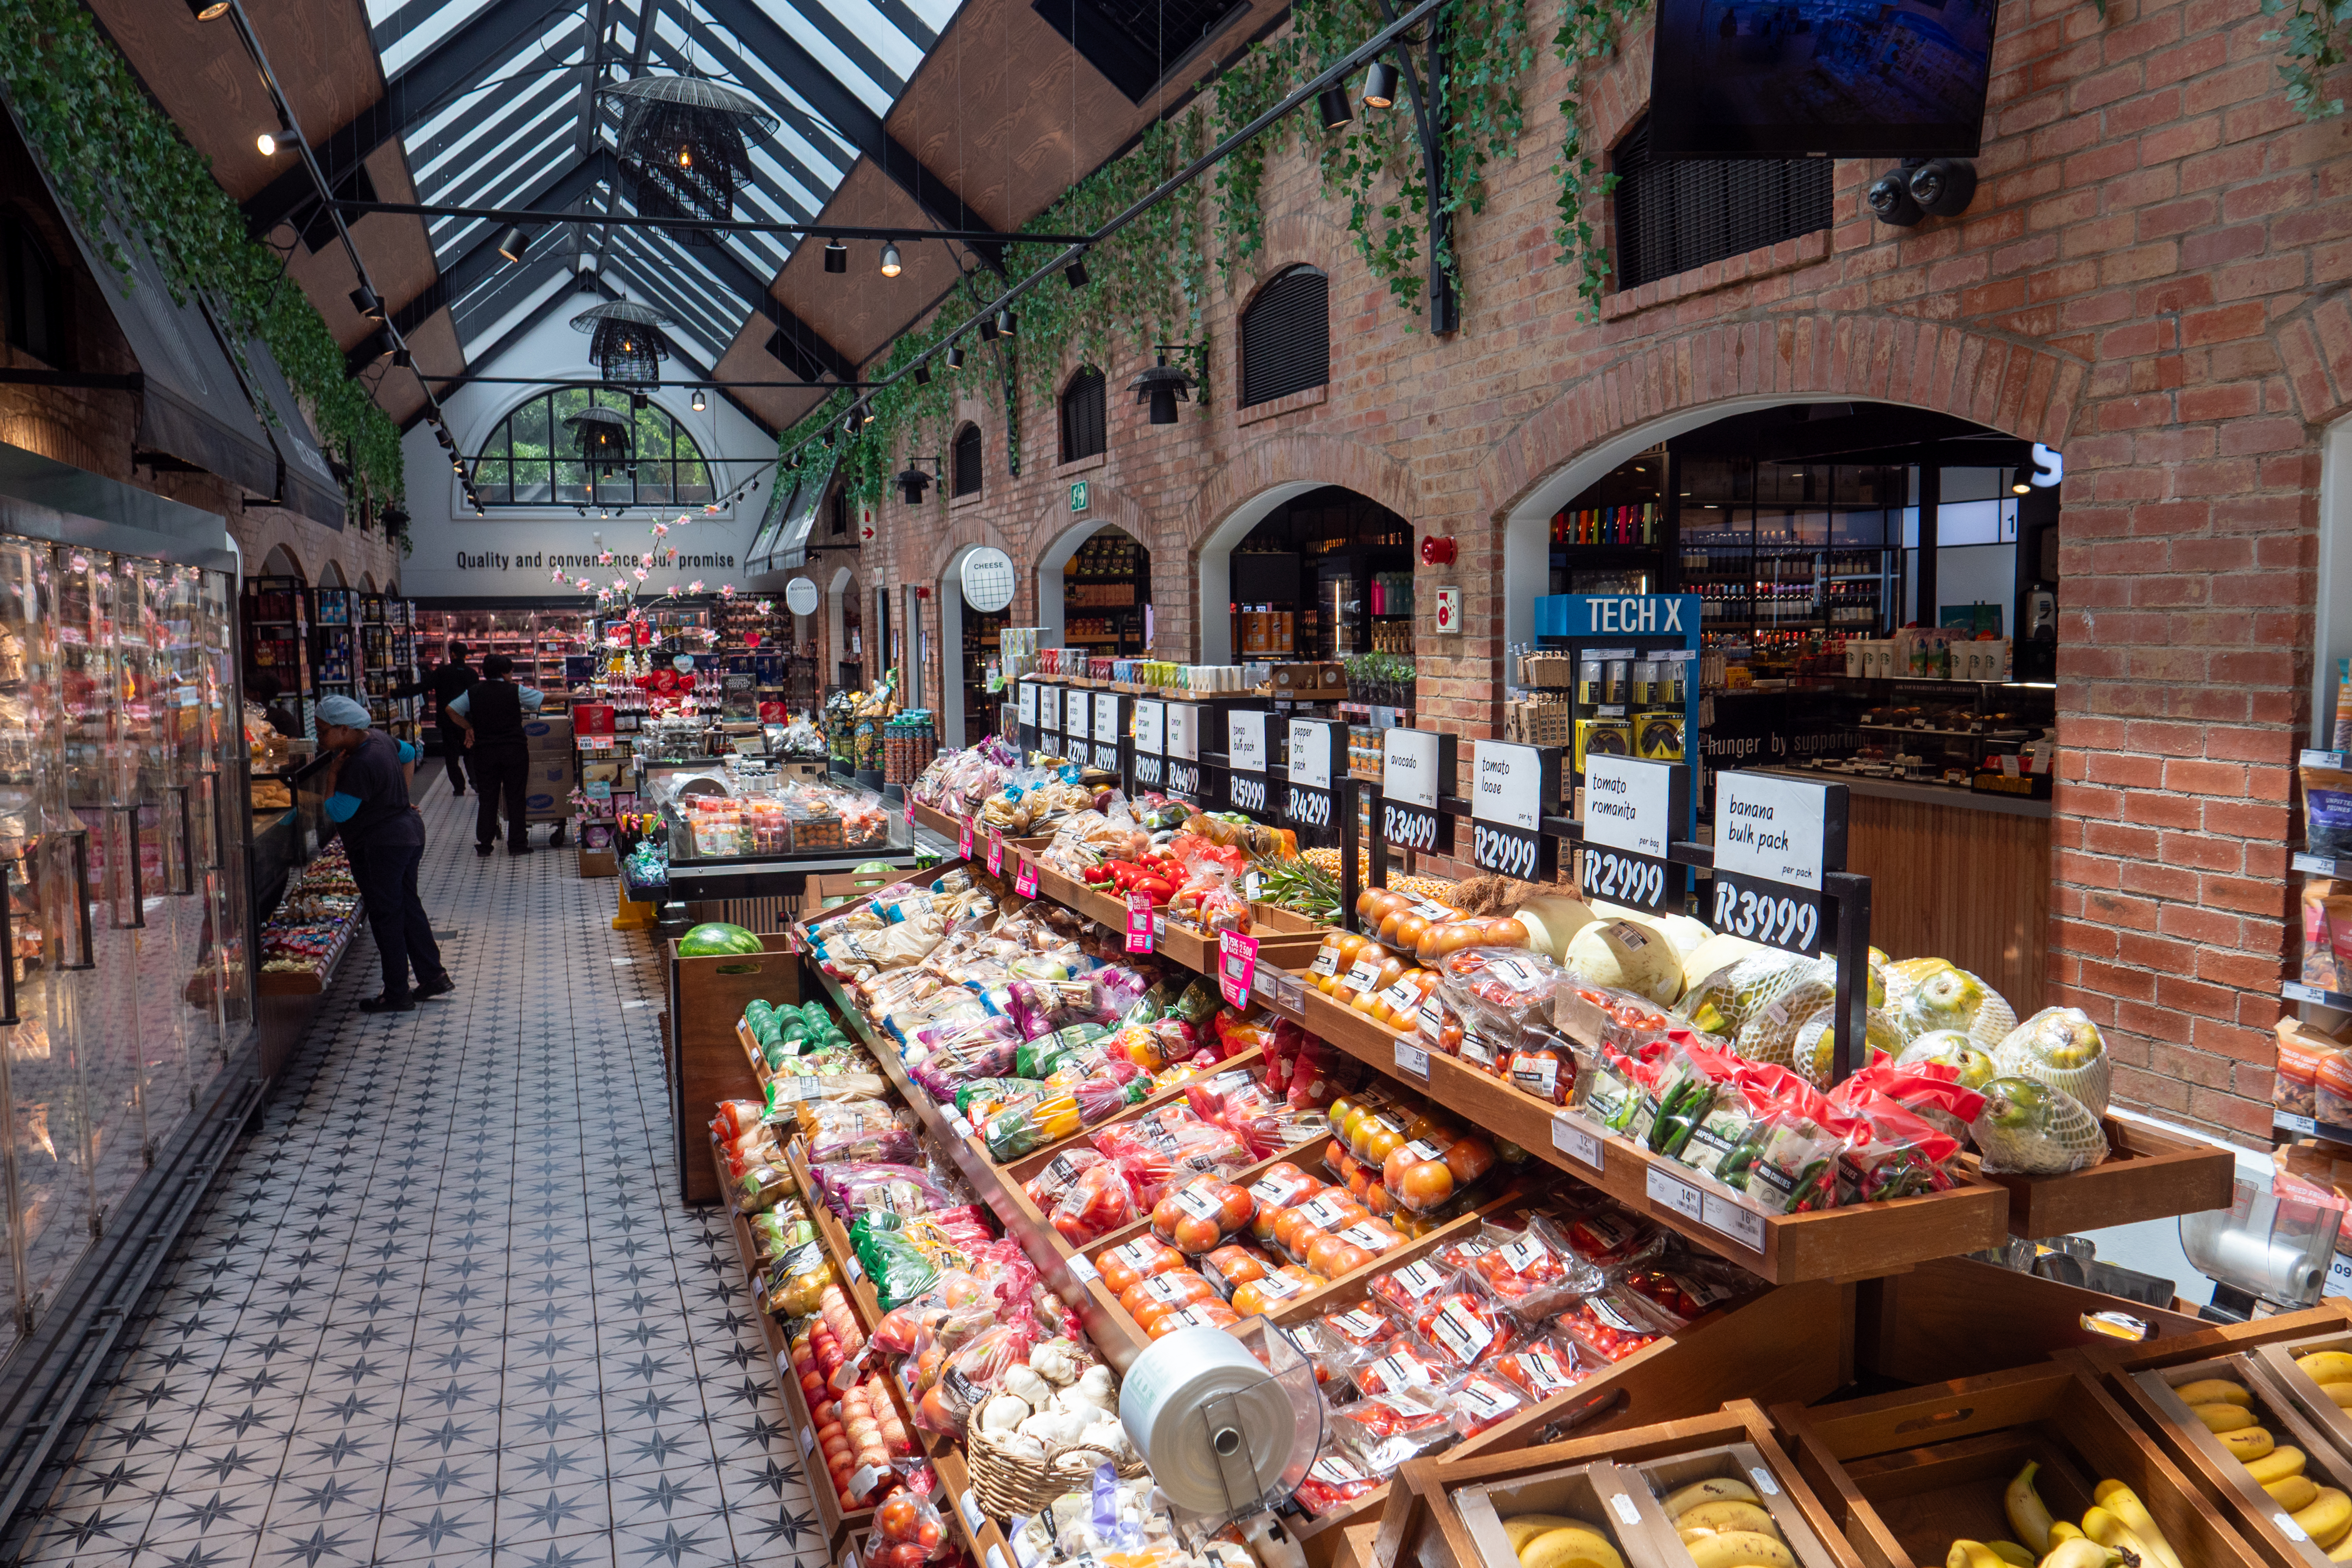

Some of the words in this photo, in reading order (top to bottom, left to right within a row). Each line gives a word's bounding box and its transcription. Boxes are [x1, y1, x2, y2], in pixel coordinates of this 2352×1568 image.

[457, 552, 509, 570] Quality
[516, 552, 542, 567] and
[549, 553, 643, 570] convennce,
[679, 552, 733, 569] promise
[974, 562, 1004, 570] CHEESE
[1586, 598, 1656, 632] TECH
[1664, 598, 1683, 632] X
[1139, 704, 1148, 713] onion
[1138, 718, 1149, 728] brown
[1171, 715, 1182, 727] onion
[1233, 724, 1245, 739] tango
[1294, 727, 1312, 742] pepper
[1234, 739, 1243, 752] bulk
[1244, 740, 1255, 756] pack
[1294, 741, 1304, 754] trio
[1708, 734, 1761, 759] hunger
[1771, 731, 1786, 756] by
[1794, 729, 1871, 756] supporting
[1294, 758, 1306, 774] pack
[1391, 754, 1417, 769] avocado
[1482, 756, 1510, 775] tomato
[1482, 776, 1501, 795] loose
[1593, 773, 1627, 794] tomato
[1703, 768, 1713, 787] it
[1230, 775, 1265, 811] R59.99
[1290, 788, 1331, 827] R42.99
[1729, 794, 1774, 821] banana
[2326, 797, 2352, 807] UNPITTE
[2327, 805, 2351, 813] PRUNES
[1518, 812, 1527, 822] per
[1592, 800, 1636, 821] romanita
[1384, 805, 1437, 851] R34.99
[1639, 837, 1649, 848] per
[1649, 837, 1659, 853] bag
[1728, 821, 1754, 845] bulk
[1757, 830, 1789, 854] pack
[1474, 825, 1536, 879] R29.99
[1584, 849, 1664, 908] R29.99
[1782, 865, 1795, 877] per
[1796, 867, 1812, 880] pack
[1714, 881, 1818, 951] R39.99
[1229, 936, 1239, 948] 75%
[2340, 934, 2352, 943] DRIE
[1229, 947, 1239, 955] BACK
[2281, 1047, 2300, 1059] PEELED
[2322, 1066, 2336, 1077] CLING
[2325, 1059, 2343, 1071] PEELED
[1595, 1100, 1610, 1114] CHILLIES
[1644, 1097, 1658, 1115] CHILLIES
[1714, 1137, 1733, 1150] CHILLIES
[1759, 1165, 1771, 1179] MIXED
[1770, 1172, 1792, 1190] CHILLIES
[2286, 1184, 2308, 1195] DRIED
[2308, 1191, 2331, 1201] FRUIT
[2293, 1195, 2317, 1205] STRIPS
[1454, 1323, 1469, 1340] TOMATOES
[954, 1372, 969, 1386] ROMA
[967, 1381, 990, 1398] TOMATO
[1044, 1509, 1054, 1532] GARLIC
